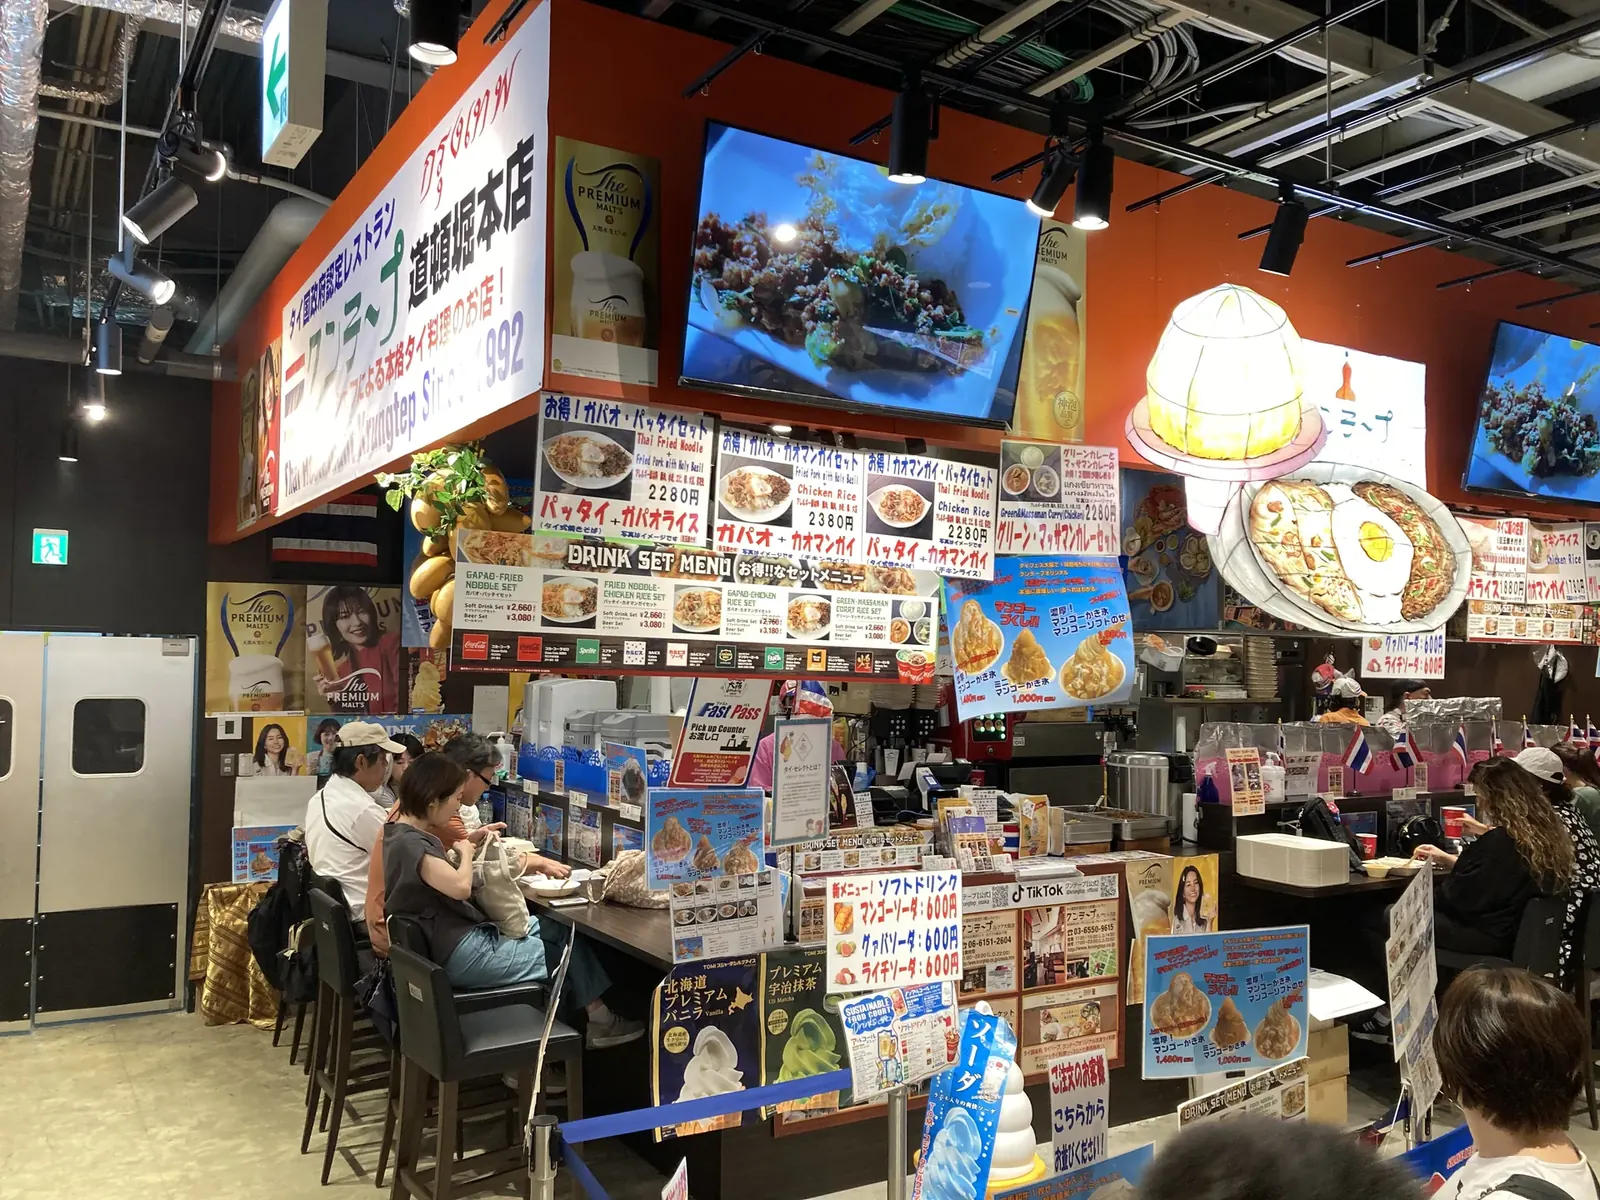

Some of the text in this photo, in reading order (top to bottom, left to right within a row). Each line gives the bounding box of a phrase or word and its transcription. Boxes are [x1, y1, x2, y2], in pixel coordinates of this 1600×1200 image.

[593, 171, 628, 194] The
[578, 186, 640, 211] PREMIUM
[596, 203, 624, 215] MALT'S
[406, 133, 535, 314] 道頓堀本店
[289, 198, 396, 341] タイ国政府認定レストラン
[589, 309, 627, 322] PREMIUM
[357, 390, 417, 457] Krungtep
[545, 396, 707, 440] お得！ガパオ・パッタイセット
[637, 432, 704, 454] Thai Fried Noodle
[722, 430, 858, 471] お得！ガパオ・カオマンガイセット
[868, 453, 993, 489] お得！カオマンガイ・パッタイセット
[649, 484, 699, 506] 2280円
[797, 484, 857, 501] Chicken Rice
[952, 485, 969, 499] Fried
[541, 495, 699, 534] パッタイ ガパオライス
[938, 500, 990, 519] Chicken Rice
[1085, 504, 1117, 523] 2280円
[809, 511, 854, 531] 2380円
[716, 523, 856, 557] ガパオ カオマンガイ
[948, 524, 988, 544] 2280円
[997, 521, 1117, 552] グリーン・マッサマンカレーセット
[567, 543, 731, 578] DRINK SET MENU
[866, 537, 989, 570] パッタイ カオマンガイ
[465, 581, 518, 592] NOODLE SET
[603, 580, 627, 589] FRIED
[244, 598, 273, 613] The
[603, 590, 634, 599] CHICKEN
[652, 593, 666, 601] SET
[231, 613, 284, 623] PREMIUM
[1051, 607, 1110, 627] マンゴーかき氷
[1052, 613, 1127, 637] マンゴーソフトのせ
[341, 675, 369, 692] The
[995, 677, 1050, 696] マンゴーかき氷
[327, 692, 380, 702] PREMIUM
[697, 701, 762, 720] Fast Pass
[689, 732, 719, 742] お渡し口
[691, 723, 747, 735] Pick up Counter
[832, 880, 874, 899] 新メニュー！
[878, 874, 958, 896] ソフトドリンク
[1026, 884, 1064, 899] TikTok
[770, 962, 823, 980] プレミアム
[664, 974, 708, 995] 北海道
[768, 976, 817, 996] 宇治抹茶
[664, 986, 728, 1010] プレミアム
[845, 998, 891, 1017] SUSTAINABLE
[663, 1006, 703, 1023] バニラ
[847, 1006, 891, 1023] FOOD COURT
[956, 1019, 993, 1092] ソーダ
[1051, 1055, 1106, 1095] ご注文のお客様
[1184, 1085, 1249, 1120] DRINK SET MENU
[1054, 1099, 1105, 1132] こちらから
[1054, 1132, 1106, 1173] お並びください！
